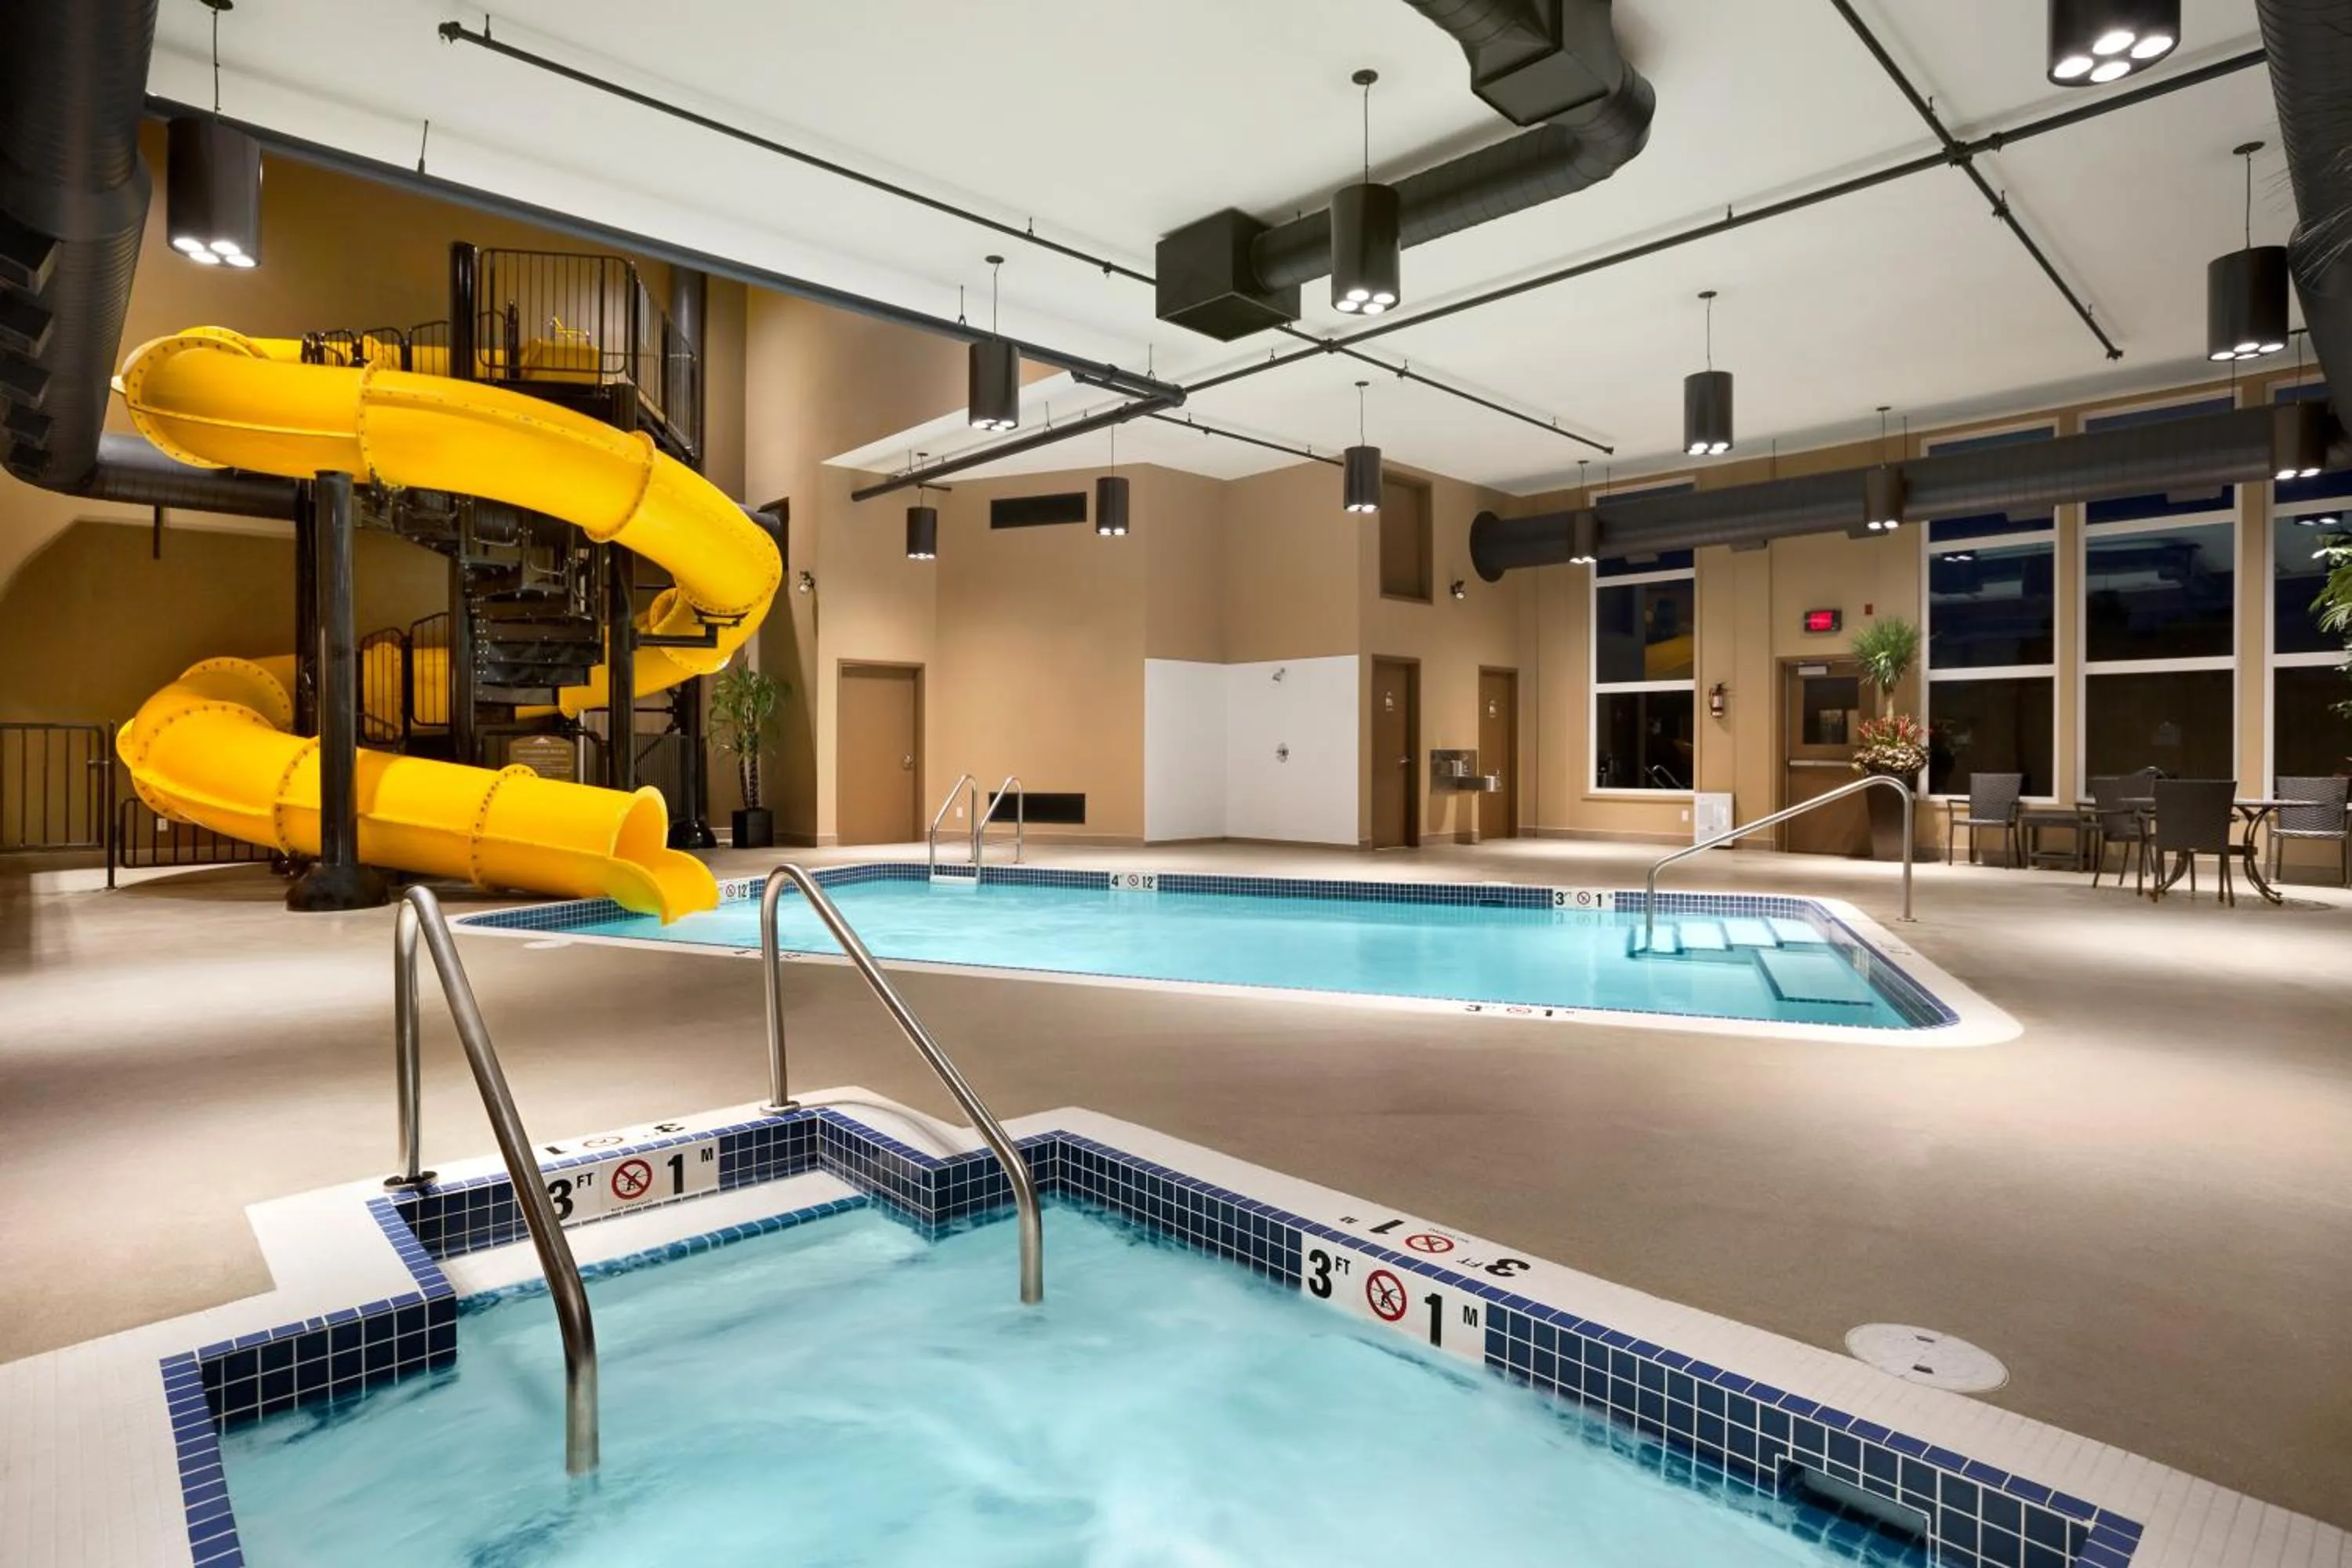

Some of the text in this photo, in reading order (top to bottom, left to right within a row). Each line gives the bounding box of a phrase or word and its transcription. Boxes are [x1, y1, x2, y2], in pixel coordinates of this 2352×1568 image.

[1555, 891, 1564, 906] 3
[1596, 893, 1602, 908] 1
[667, 1152, 684, 1195] 1
[701, 1146, 713, 1163] M
[1485, 1258, 1531, 1277] 3
[1308, 1249, 1478, 1348] 3 FT 1 M
